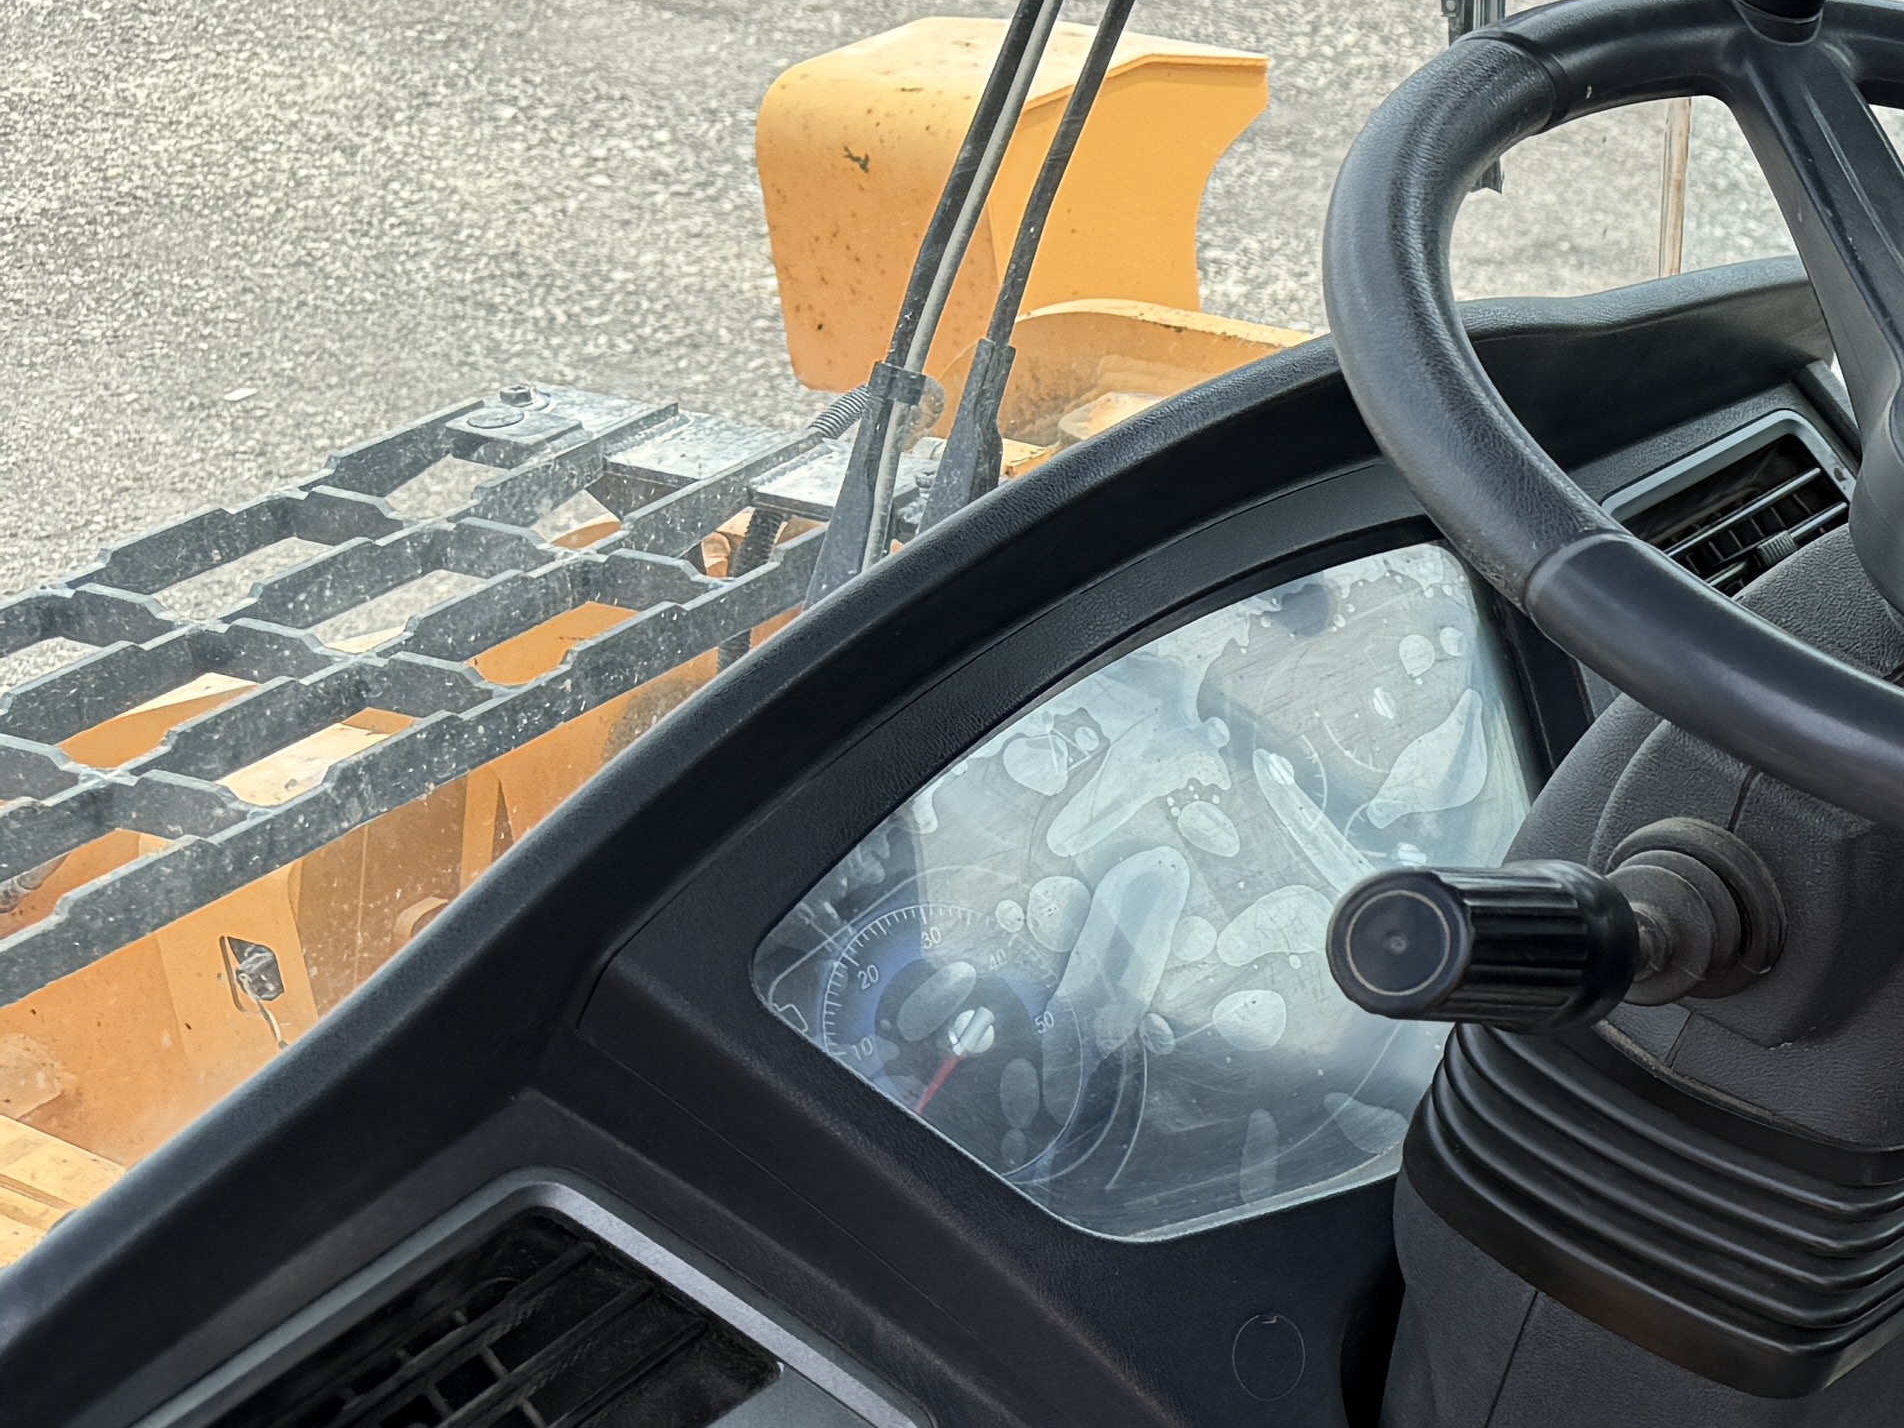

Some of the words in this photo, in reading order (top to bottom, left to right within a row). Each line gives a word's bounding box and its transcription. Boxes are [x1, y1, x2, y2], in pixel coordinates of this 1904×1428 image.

[922, 926, 943, 950] 30
[987, 949, 1008, 973] 40
[858, 964, 879, 990] 20
[1034, 1011, 1055, 1035] 50
[851, 1038, 874, 1062] 10
